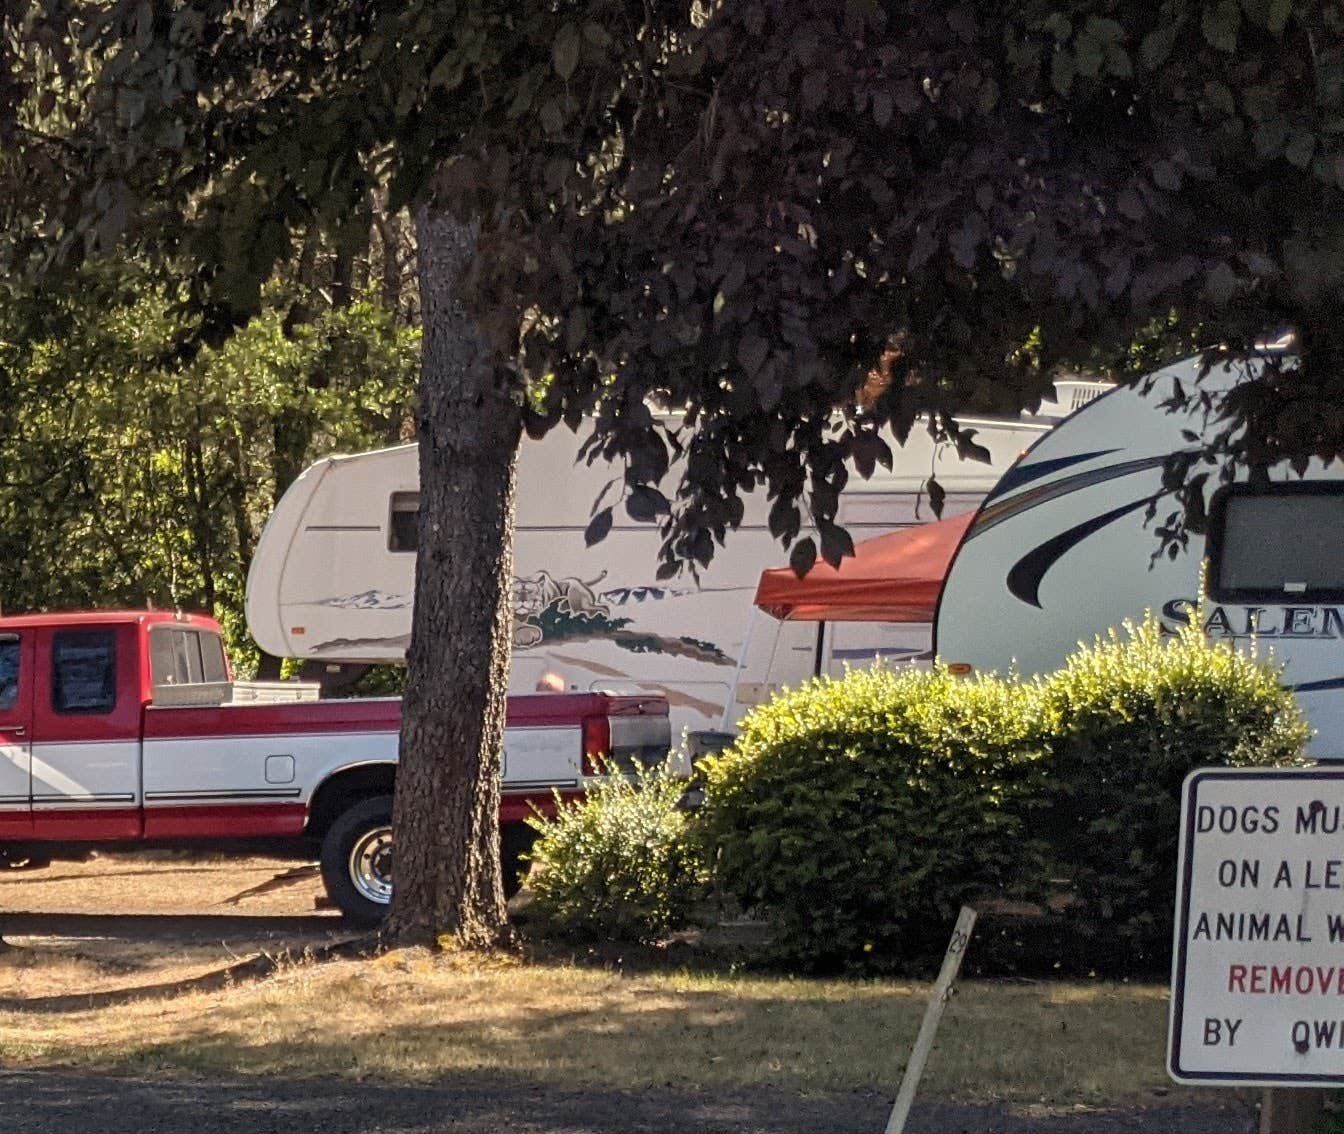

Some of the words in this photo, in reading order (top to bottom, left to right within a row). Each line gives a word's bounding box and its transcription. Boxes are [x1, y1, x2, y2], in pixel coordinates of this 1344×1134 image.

[1197, 806, 1280, 833] DOGS
[1295, 804, 1344, 834] MU
[1218, 860, 1260, 888] ON
[1273, 861, 1292, 889] A
[1305, 860, 1344, 889] LE
[1193, 912, 1312, 942] ANIMAL
[1203, 1018, 1243, 1046] BY
[1292, 1020, 1344, 1050] OW
